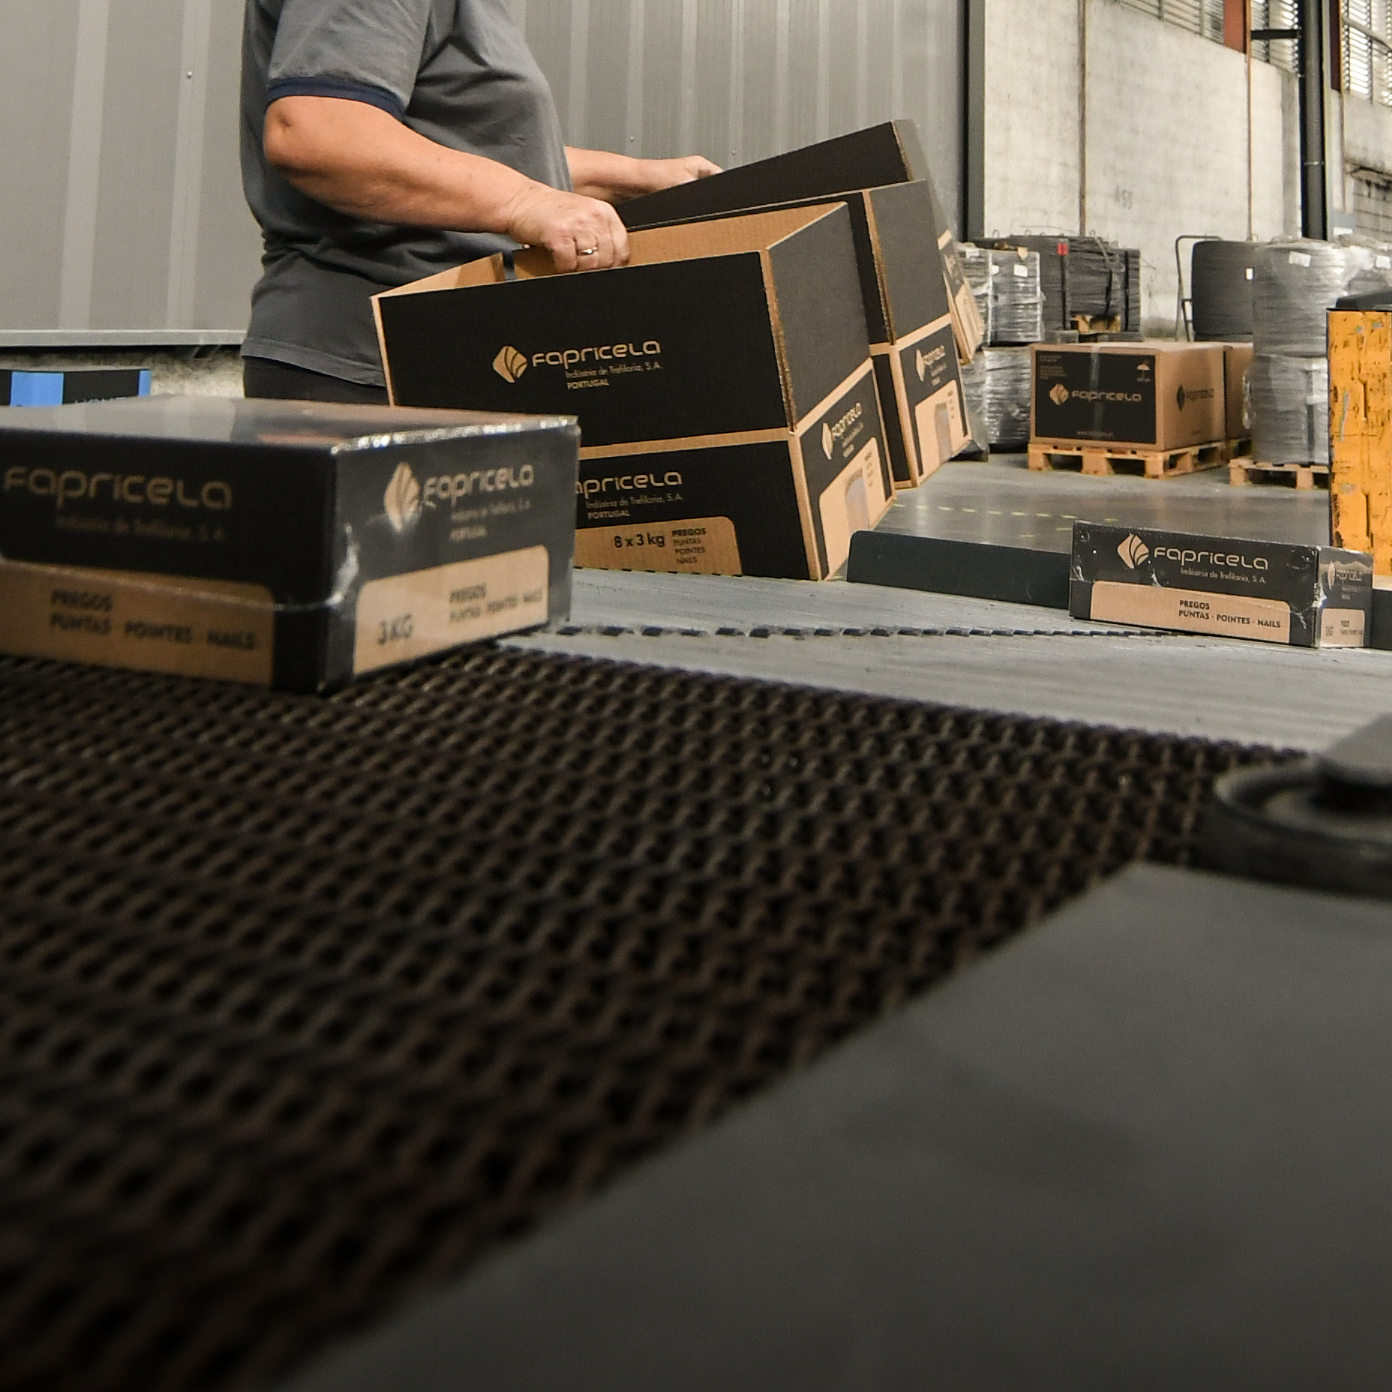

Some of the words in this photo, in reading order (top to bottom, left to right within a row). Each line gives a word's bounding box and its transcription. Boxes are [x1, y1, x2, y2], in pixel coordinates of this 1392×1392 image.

[567, 379, 610, 390] PORTUGAL
[575, 471, 683, 499] apricela
[587, 509, 630, 519] PORTUGAL
[672, 527, 706, 537] PREGOS
[614, 535, 622, 548] 8
[625, 538, 634, 547] x
[636, 534, 645, 546] 3
[647, 532, 665, 548] kg
[1209, 570, 1218, 578] de
[1179, 599, 1210, 610] PREGOS
[1179, 610, 1209, 620] PUNTAS
[1216, 614, 1250, 625] POINTES
[1257, 619, 1281, 628] NAILS
